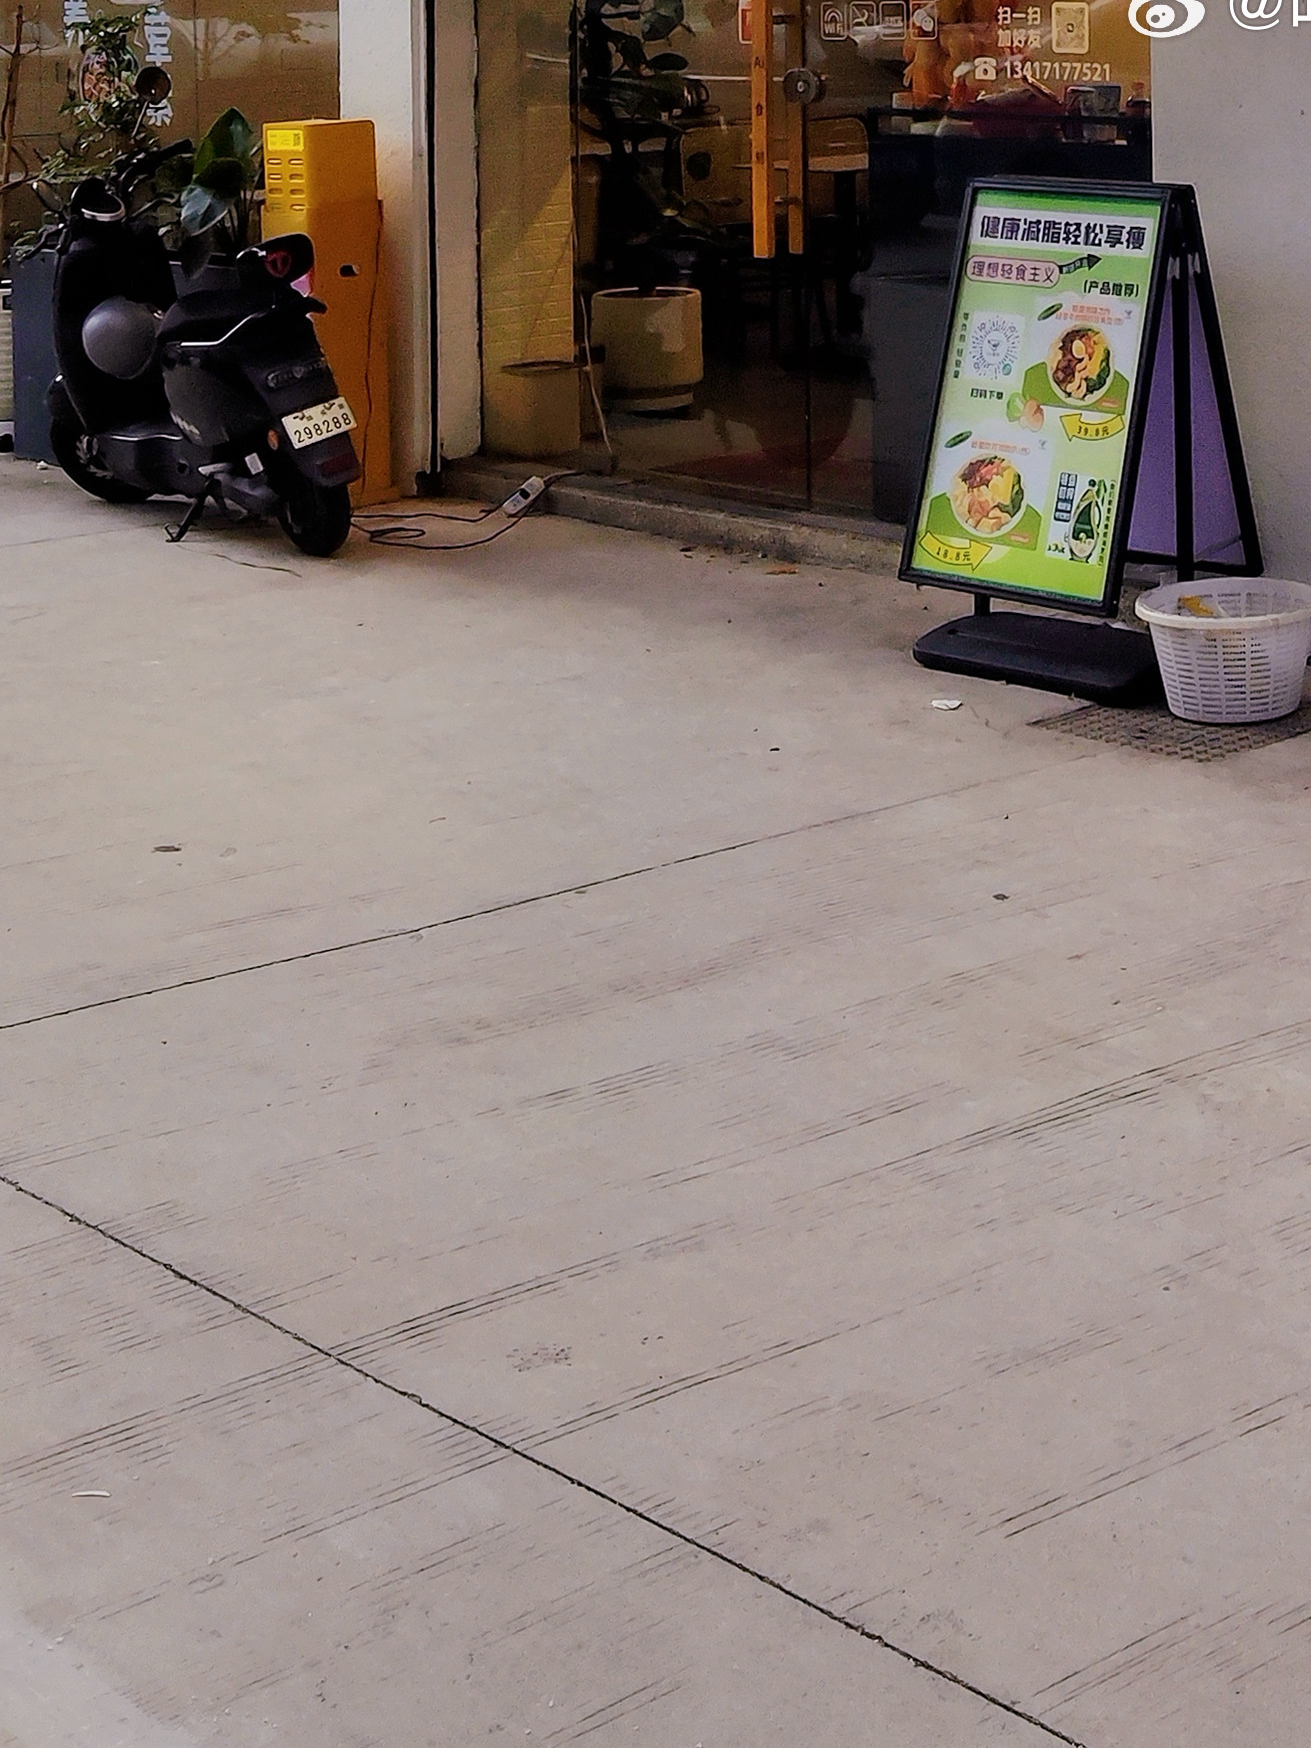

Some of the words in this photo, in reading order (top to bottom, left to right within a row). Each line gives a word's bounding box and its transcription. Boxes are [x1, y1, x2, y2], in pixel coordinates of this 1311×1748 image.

[997, 6, 1042, 26] 扫一扫
[997, 28, 1042, 49] 加好友
[1004, 60, 1111, 83] 13417177521
[979, 215, 1147, 251] 健康减脂轻松享瘦
[971, 260, 1055, 284] 理想轻食主义
[293, 412, 352, 444] 298288
